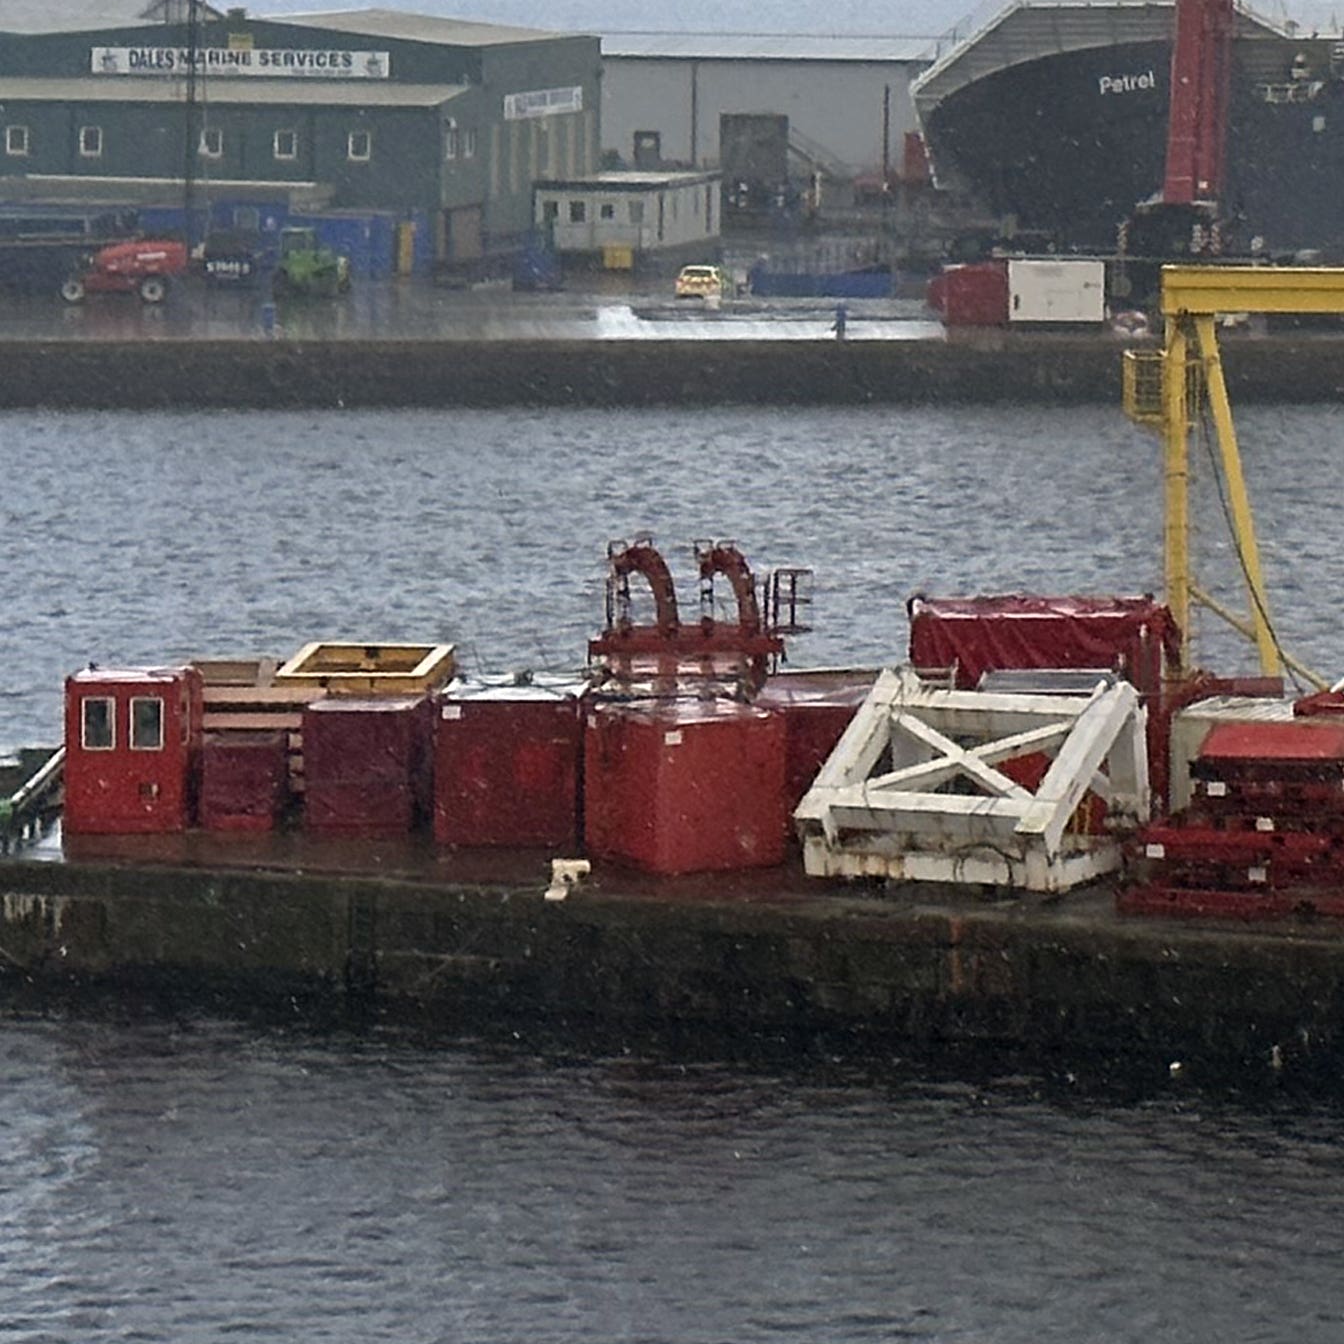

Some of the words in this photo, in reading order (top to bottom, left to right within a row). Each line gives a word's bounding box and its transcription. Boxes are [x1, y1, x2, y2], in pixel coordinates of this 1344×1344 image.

[129, 50, 174, 69] DALES
[258, 51, 353, 68] SERVICES
[1099, 70, 1155, 95] Petrel
